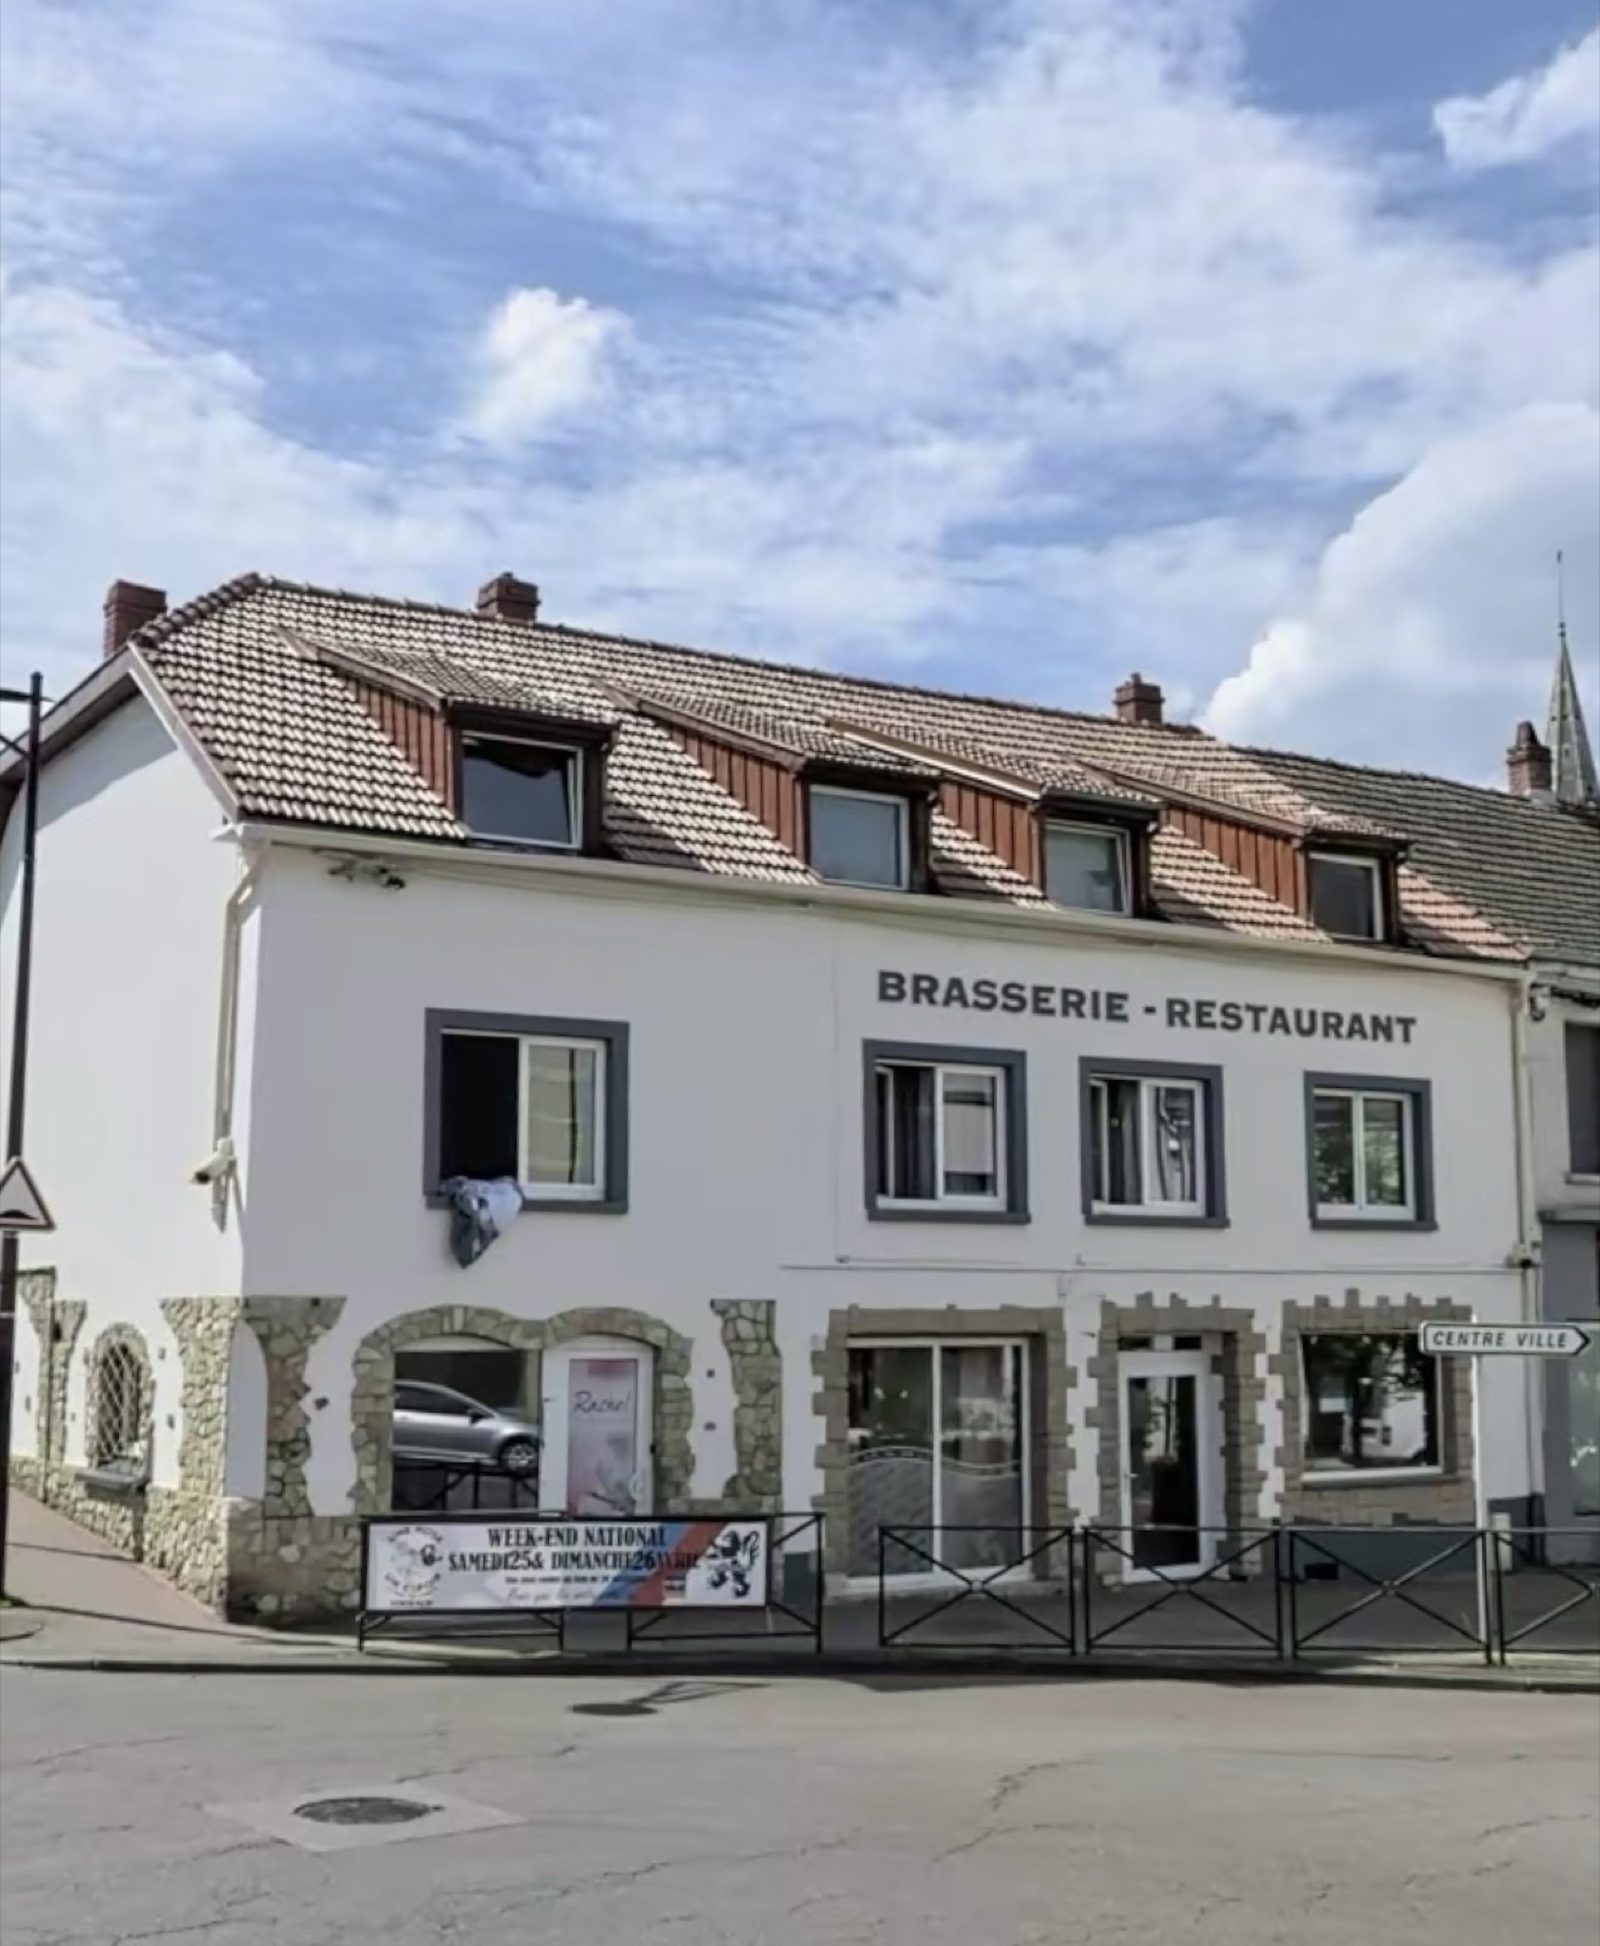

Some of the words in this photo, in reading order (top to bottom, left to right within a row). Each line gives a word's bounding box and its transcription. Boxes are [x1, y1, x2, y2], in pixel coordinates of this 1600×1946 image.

[877, 970, 1129, 1023] BRASSERIE
[1166, 998, 1417, 1044] RESTAURANT
[1433, 1330, 1505, 1346] CENTRE
[1517, 1332, 1567, 1348] VILLE
[488, 1527, 579, 1547] WEEK-END
[584, 1527, 666, 1547] NATIONAL
